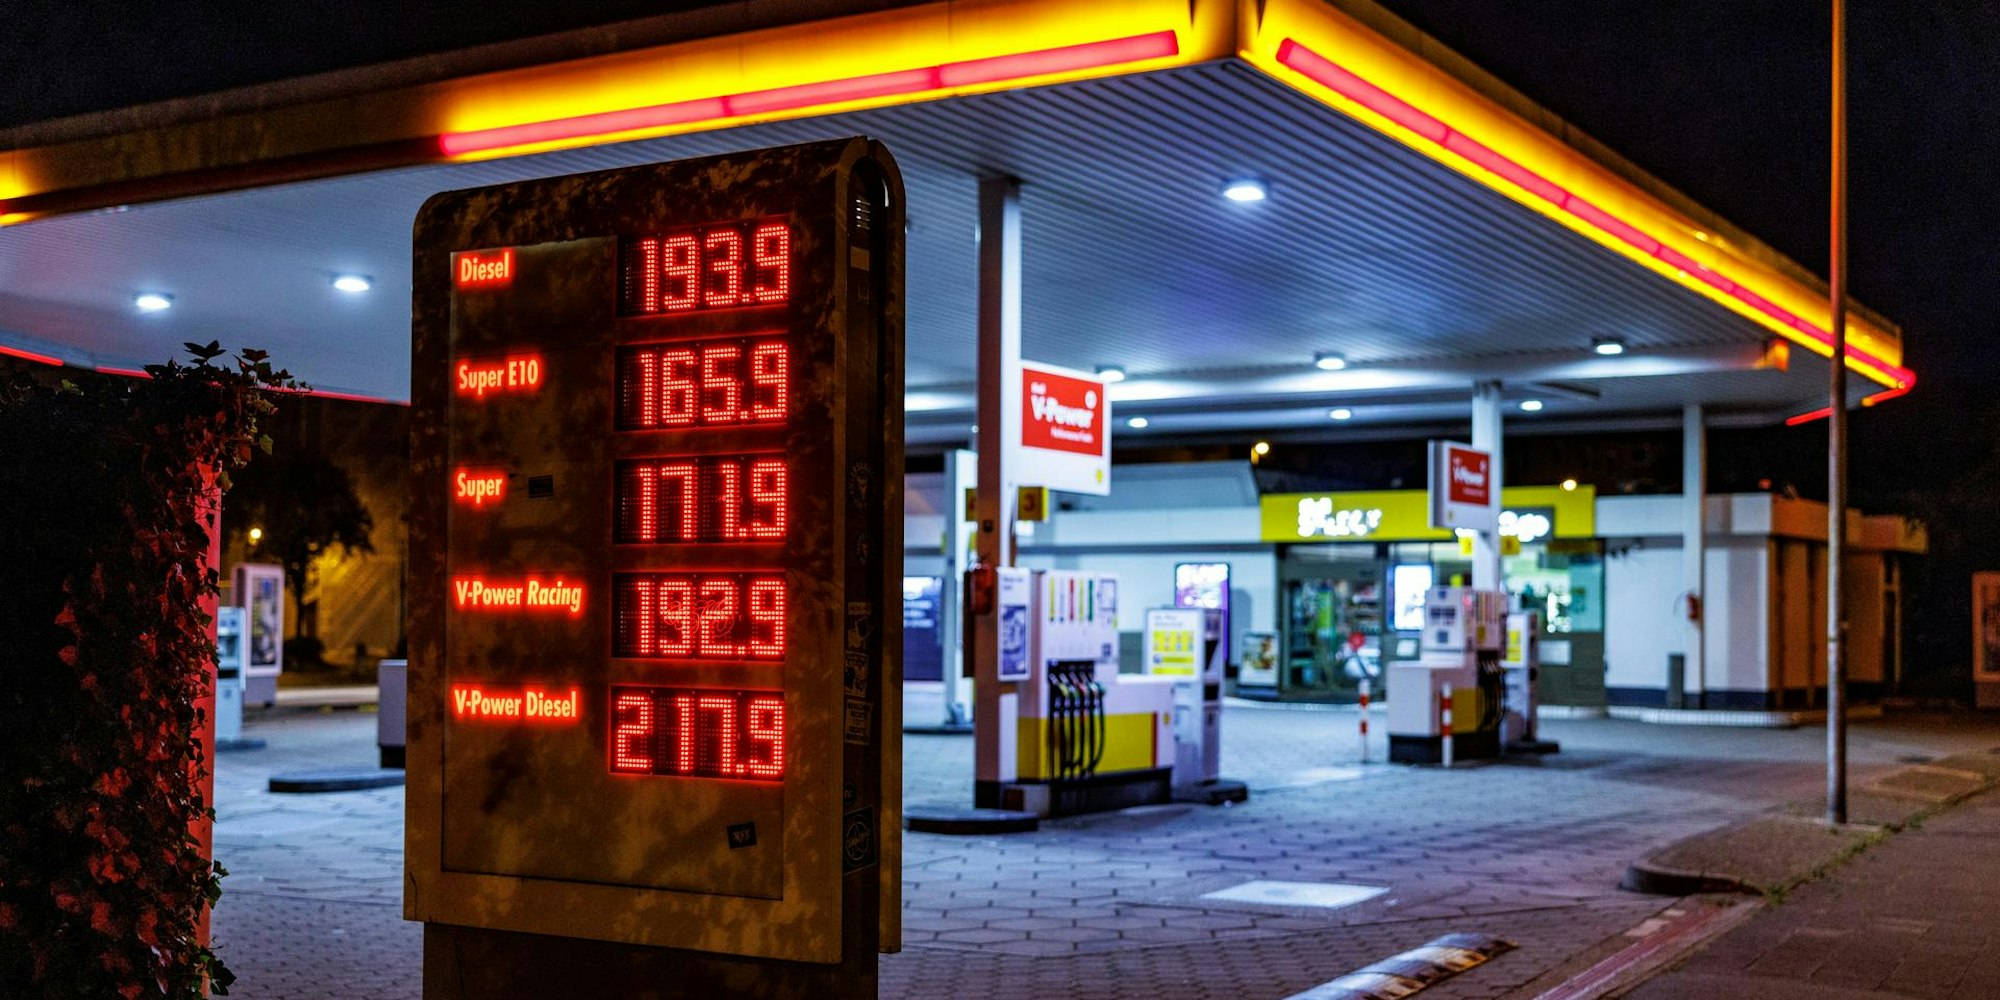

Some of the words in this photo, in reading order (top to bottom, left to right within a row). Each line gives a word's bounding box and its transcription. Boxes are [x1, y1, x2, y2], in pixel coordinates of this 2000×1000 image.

[460, 252, 510, 282] Diesel
[643, 226, 789, 311] 193.9
[458, 365, 504, 395] Super
[508, 360, 539, 386] E10
[641, 344, 787, 425] 165.9
[457, 473, 503, 503] Super
[640, 462, 786, 539] 171.9
[456, 580, 523, 606] V-Power
[527, 580, 582, 612] Racing
[638, 580, 784, 655] 192.9
[454, 689, 522, 716] V-Power
[526, 690, 577, 718] Diesel
[617, 695, 783, 775] 217.9
